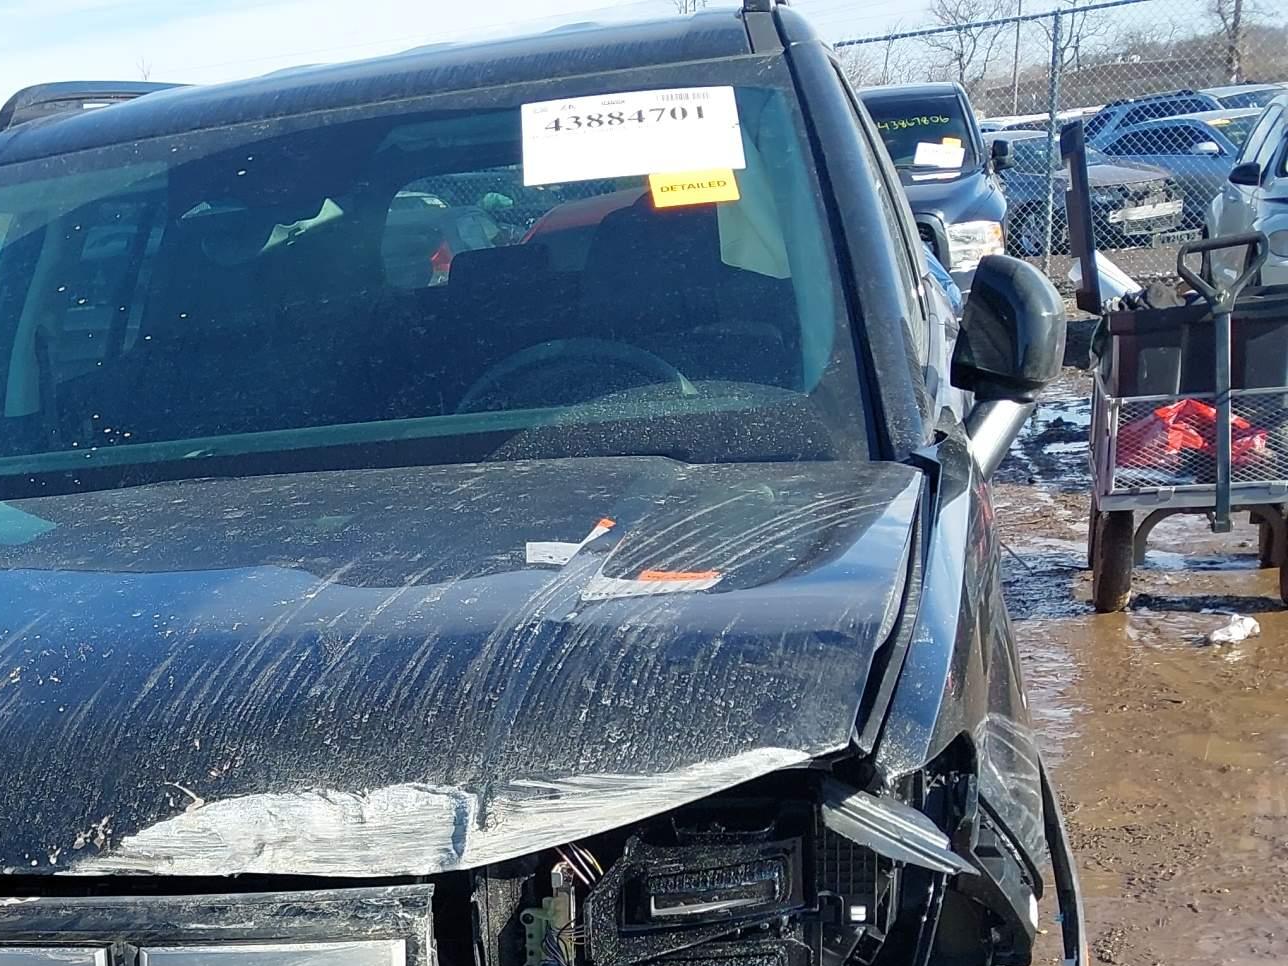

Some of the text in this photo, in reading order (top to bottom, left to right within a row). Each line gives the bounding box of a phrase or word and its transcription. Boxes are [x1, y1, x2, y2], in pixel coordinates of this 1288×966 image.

[544, 105, 705, 132] 43884701
[877, 114, 950, 131] 43867806
[660, 180, 727, 194] DETAILED
